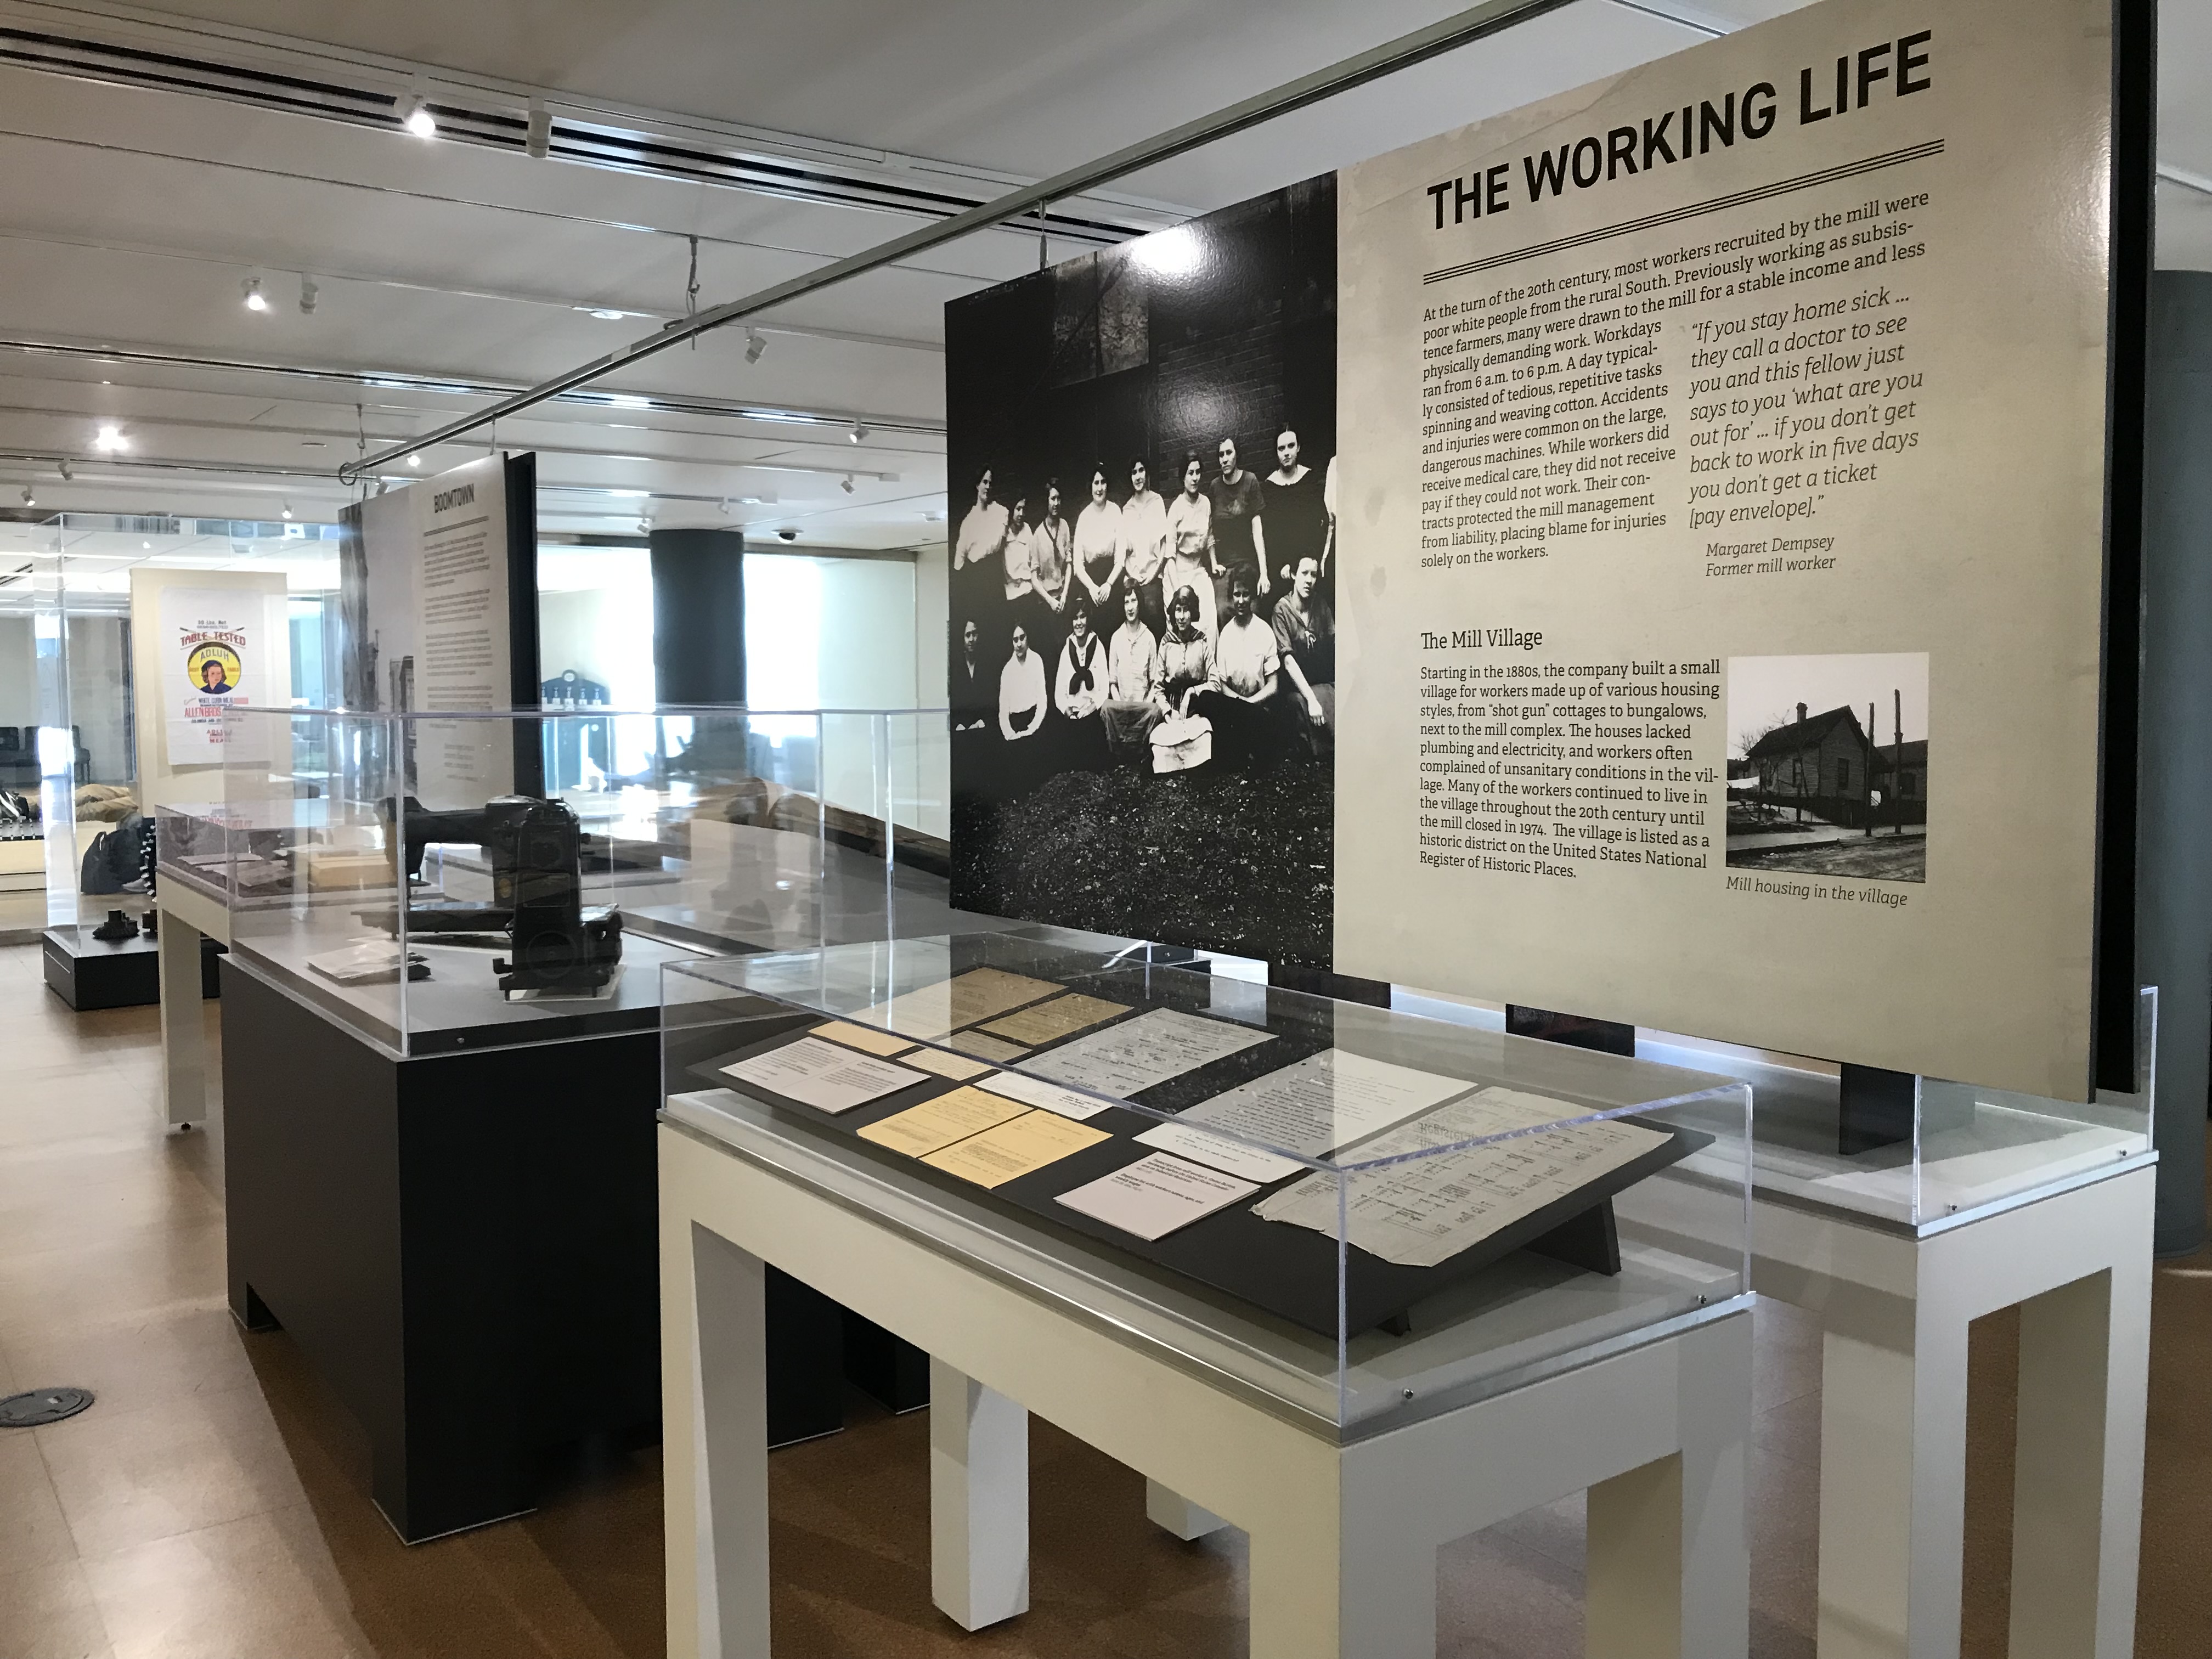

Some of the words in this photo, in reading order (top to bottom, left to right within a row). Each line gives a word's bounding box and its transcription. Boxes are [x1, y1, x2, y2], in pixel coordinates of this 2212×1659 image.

[1427, 163, 1510, 230] THE
[1523, 82, 1777, 202] WORKING
[1800, 29, 1931, 125] LIFE
[1423, 308, 1436, 322] At
[1438, 303, 1458, 318] the
[1460, 297, 1487, 314] turn
[1488, 290, 1503, 306] of
[1504, 287, 1525, 303] the
[1526, 278, 1556, 298] 20th
[1556, 268, 1611, 290] century,
[1613, 257, 1649, 278] most
[1651, 244, 1711, 268] workers
[1712, 222, 1785, 255] recruited
[1790, 220, 1810, 239] by
[1813, 212, 1842, 231] the
[1846, 199, 1880, 224] mill
[1883, 193, 1929, 214] were
[1423, 325, 1449, 345] poor
[1451, 316, 1486, 334] white
[1487, 306, 1527, 330] people
[1529, 300, 1561, 318] from
[1564, 293, 1586, 309] the
[1588, 282, 1623, 304] rural
[1625, 273, 1671, 296] South.
[1674, 255, 1754, 286] Previously
[1757, 240, 1825, 268] working
[1827, 235, 1848, 251] as
[1850, 219, 1914, 249] subsis-
[1423, 344, 1453, 360] tence
[1455, 334, 1504, 353] farmers,
[1506, 325, 1542, 343] many
[1543, 318, 1576, 334] were
[1578, 308, 1621, 327] drawn
[1623, 303, 1638, 318] to
[1641, 297, 1665, 314] the
[1668, 287, 1697, 308] mill
[1699, 285, 1722, 302] for
[1725, 284, 1735, 296] a
[1737, 270, 1785, 294] stable
[1788, 259, 1850, 283] income
[1853, 246, 1887, 270] and
[1891, 241, 1925, 262] less
[1423, 356, 1480, 382] physically
[1482, 343, 1551, 367] demanding
[1554, 332, 1590, 352] work.
[1593, 321, 1661, 344] Workdays
[1691, 348, 1729, 369] they
[1732, 337, 1764, 360] call
[1768, 340, 1779, 354] a
[1784, 328, 1846, 352] doctor
[1851, 323, 1871, 340] to
[1874, 317, 1908, 336] see
[1688, 376, 1721, 399] you
[1725, 364, 1760, 389] and
[1765, 360, 1800, 382] this
[1804, 352, 1862, 381] fellow
[1863, 344, 1905, 371] just
[1422, 416, 1472, 438] spinning
[1474, 409, 1497, 427] and
[1499, 403, 1551, 422] weaving
[1553, 397, 1598, 414] cotton.
[1600, 383, 1668, 407] Accidents
[1421, 455, 1481, 474] dangerous
[1483, 446, 1545, 465] machines.
[1548, 437, 1585, 455] While
[1588, 431, 1644, 449] workers
[1647, 424, 1669, 441] did
[1690, 450, 1731, 473] back
[1735, 452, 1753, 467] to
[1757, 441, 1804, 465] work
[1809, 439, 1827, 459] in
[1832, 436, 1867, 461] five
[1872, 430, 1919, 454] days
[435, 483, 475, 513] BOOMTOWN
[1687, 483, 1720, 504] you
[1773, 472, 1802, 495] get
[1806, 472, 1818, 487] a
[1823, 462, 1878, 486] ticket
[1421, 516, 1454, 530] tracts
[1456, 506, 1513, 529] protected
[1515, 505, 1537, 520] the
[1539, 500, 1564, 522] mill
[1566, 492, 1655, 514] management
[1689, 507, 1725, 529] [pay
[1421, 535, 1449, 549] from
[1451, 529, 1498, 546] liability,
[1500, 524, 1545, 545] placing
[1548, 521, 1588, 536] blame
[1590, 517, 1611, 532] for
[1613, 511, 1666, 533] injuries
[1705, 540, 1768, 558] Margaret
[1770, 537, 1835, 553] Dempsey
[1705, 562, 1754, 577] Former
[1756, 557, 1783, 573] mill
[1786, 555, 1836, 571] worker
[180, 631, 208, 646] TABLE
[214, 631, 246, 646] TESTED
[200, 648, 229, 662] ADLUH
[1420, 631, 1447, 650] The
[1451, 629, 1482, 648] Mill
[1486, 628, 1543, 651] Village
[1420, 665, 1467, 682] Starting
[1469, 665, 1481, 678] in
[1483, 664, 1504, 678] the
[1505, 665, 1541, 679] 1880s,
[1543, 662, 1565, 677] the
[1567, 665, 1629, 680] company
[1631, 659, 1666, 675] built
[1668, 663, 1677, 675] a
[1680, 658, 1720, 675] small
[184, 707, 204, 718] ALLEN
[1420, 703, 1455, 719] styles,
[1457, 703, 1486, 716] from
[1553, 704, 1606, 721] cottages
[1609, 704, 1623, 717] to
[1626, 702, 1707, 721] bungalows,
[1420, 740, 1475, 758] plumbing
[1476, 741, 1499, 755] and
[1502, 742, 1566, 760] electricity,
[1568, 743, 1594, 758] and
[1596, 744, 1652, 759] workers
[1655, 744, 1693, 760] often
[1419, 832, 1462, 848] historic
[1464, 835, 1508, 852] district
[1510, 843, 1526, 854] on
[1528, 840, 1549, 855] the
[1552, 842, 1596, 859] United
[1599, 846, 1641, 863] States
[1644, 849, 1707, 868] National
[1419, 850, 1465, 868] Register
[1467, 855, 1481, 868] of
[1482, 856, 1531, 873] Historic
[1533, 860, 1576, 878] Places.
[1725, 876, 1752, 891] Mill
[1754, 877, 1810, 900] housing
[1814, 883, 1827, 899] in
[1831, 885, 1855, 901] the
[1858, 887, 1908, 909] village
